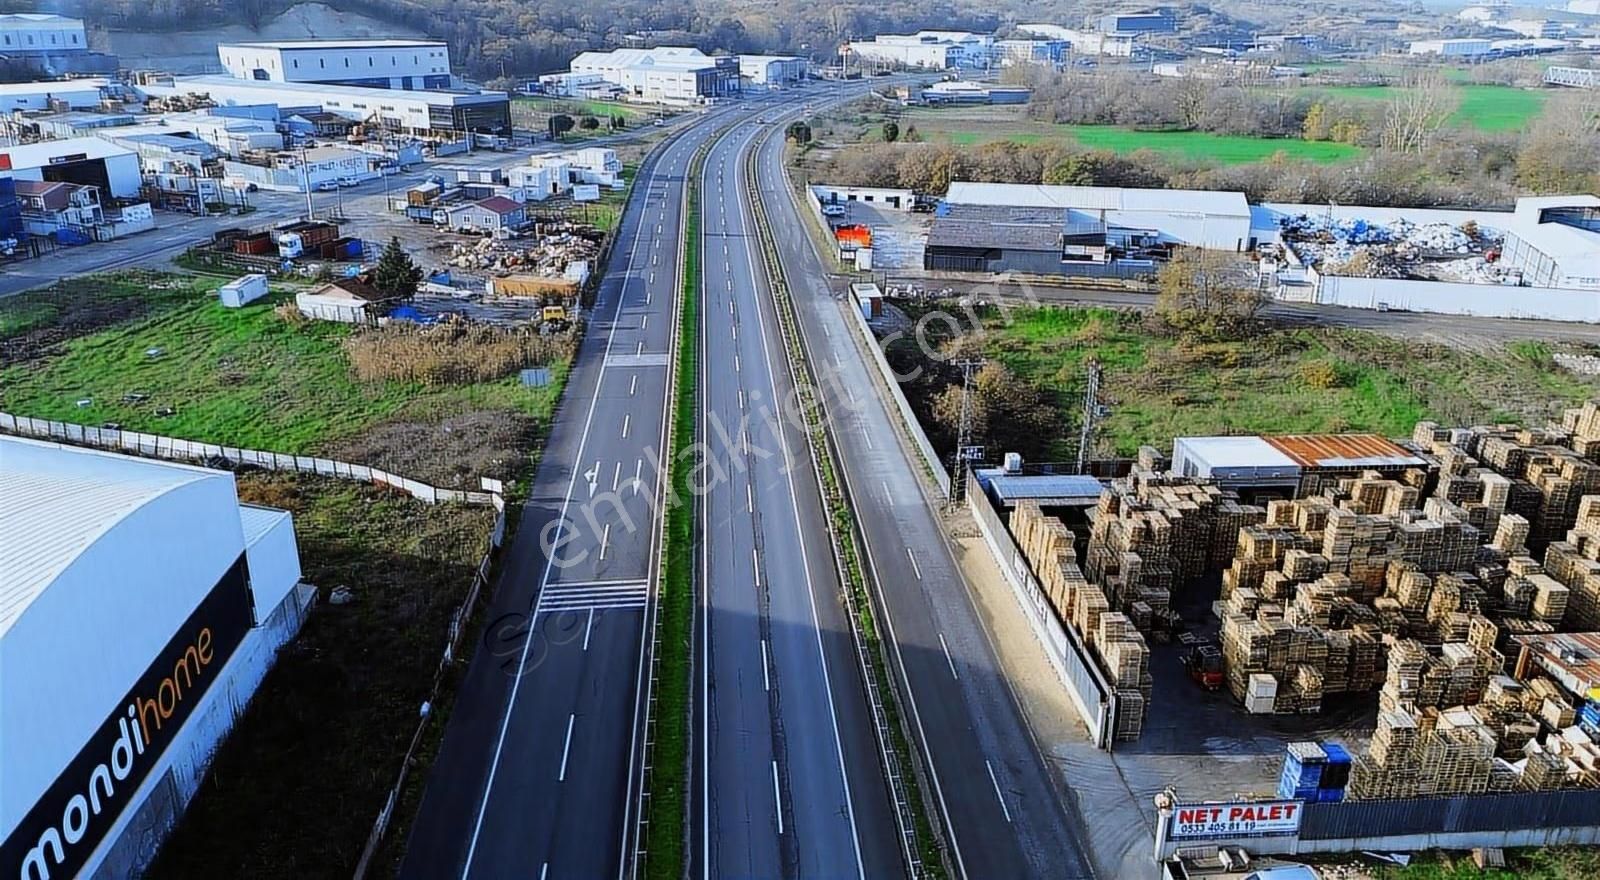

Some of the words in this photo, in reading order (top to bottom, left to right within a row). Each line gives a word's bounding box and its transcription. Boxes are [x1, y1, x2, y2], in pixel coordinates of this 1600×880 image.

[21, 628, 213, 880] mondihome
[1179, 808, 1223, 824] NET
[1229, 806, 1297, 822] PALET
[1180, 824, 1205, 834] 0533
[1208, 823, 1226, 832] 405
